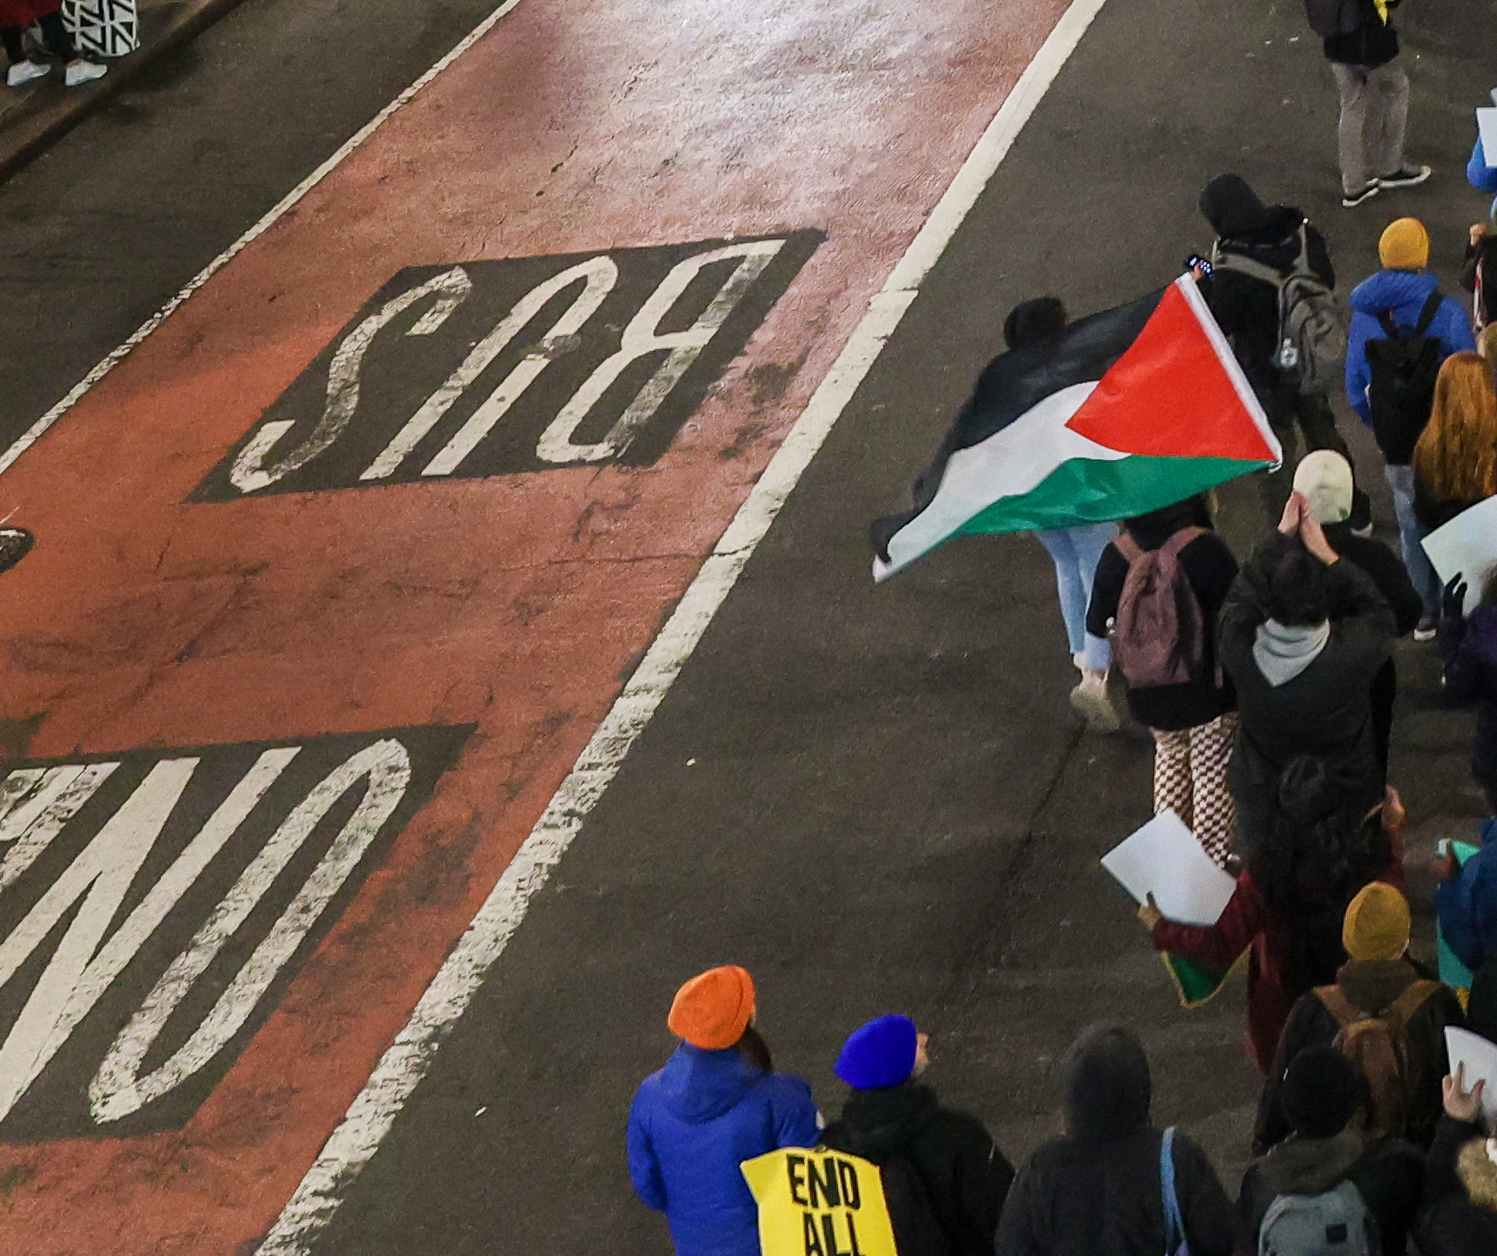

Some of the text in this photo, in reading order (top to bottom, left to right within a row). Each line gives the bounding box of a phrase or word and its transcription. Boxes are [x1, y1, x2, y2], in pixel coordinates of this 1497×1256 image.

[229, 238, 788, 494] BUS
[0, 737, 412, 1125] ON
[785, 1153, 862, 1211] END
[802, 1210, 867, 1256] ALL
